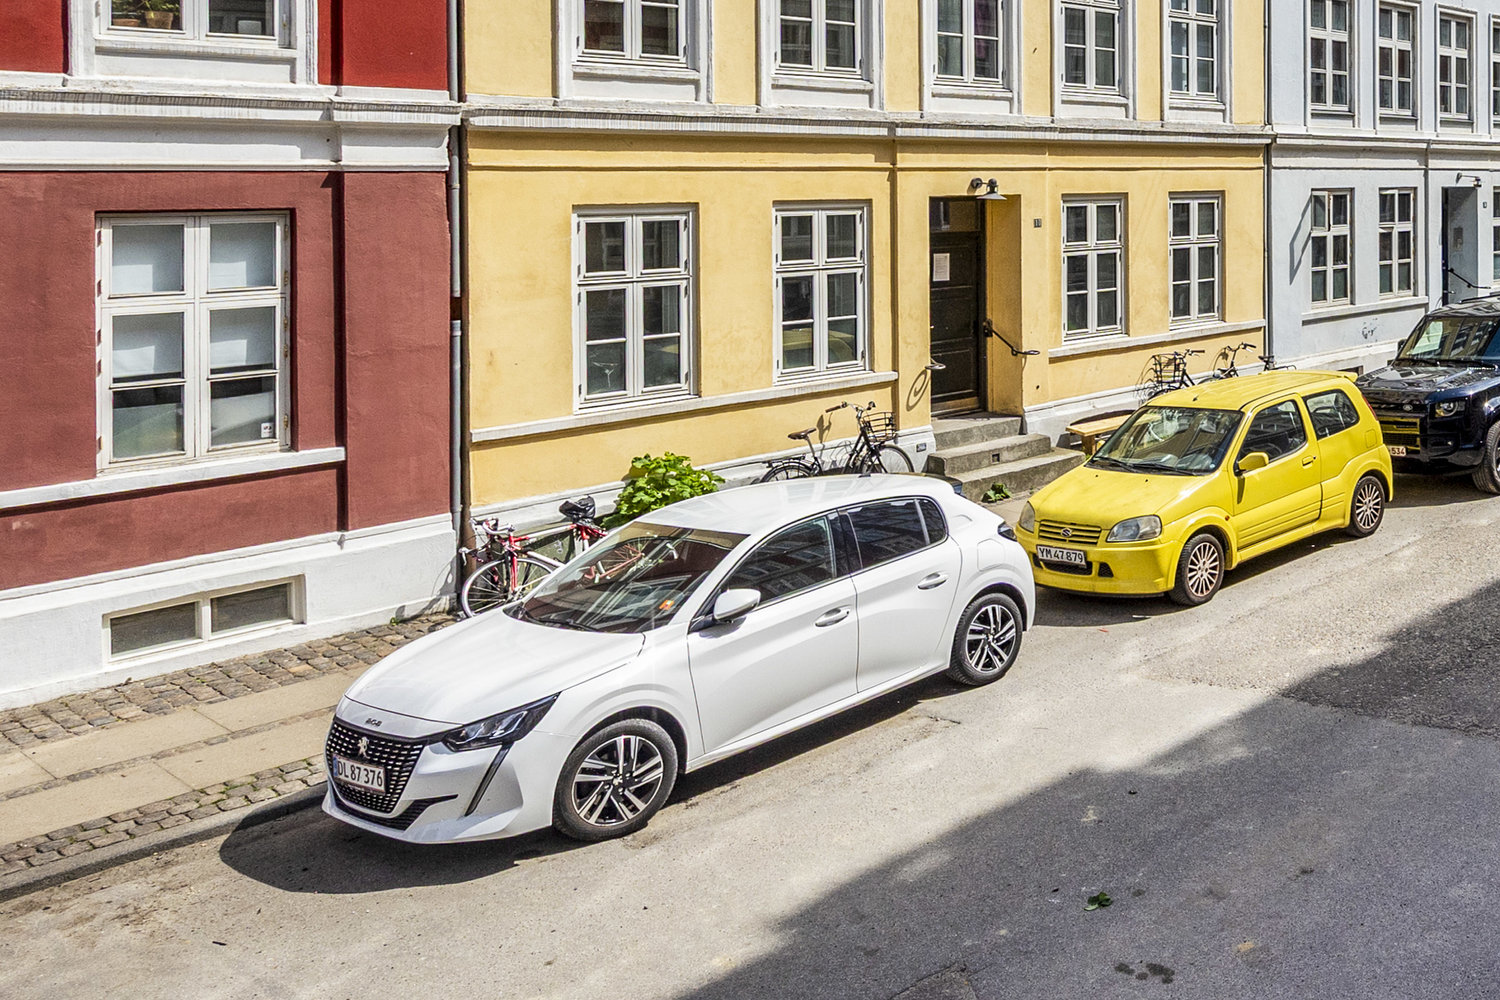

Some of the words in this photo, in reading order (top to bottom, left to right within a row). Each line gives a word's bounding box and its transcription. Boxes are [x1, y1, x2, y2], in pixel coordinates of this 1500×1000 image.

[1391, 447, 1405, 455] 534
[1039, 547, 1053, 559] YM
[1053, 550, 1065, 560] 47
[1065, 551, 1083, 563] 879
[338, 760, 349, 779] DL
[350, 764, 362, 782] 87
[363, 768, 383, 787] 376
